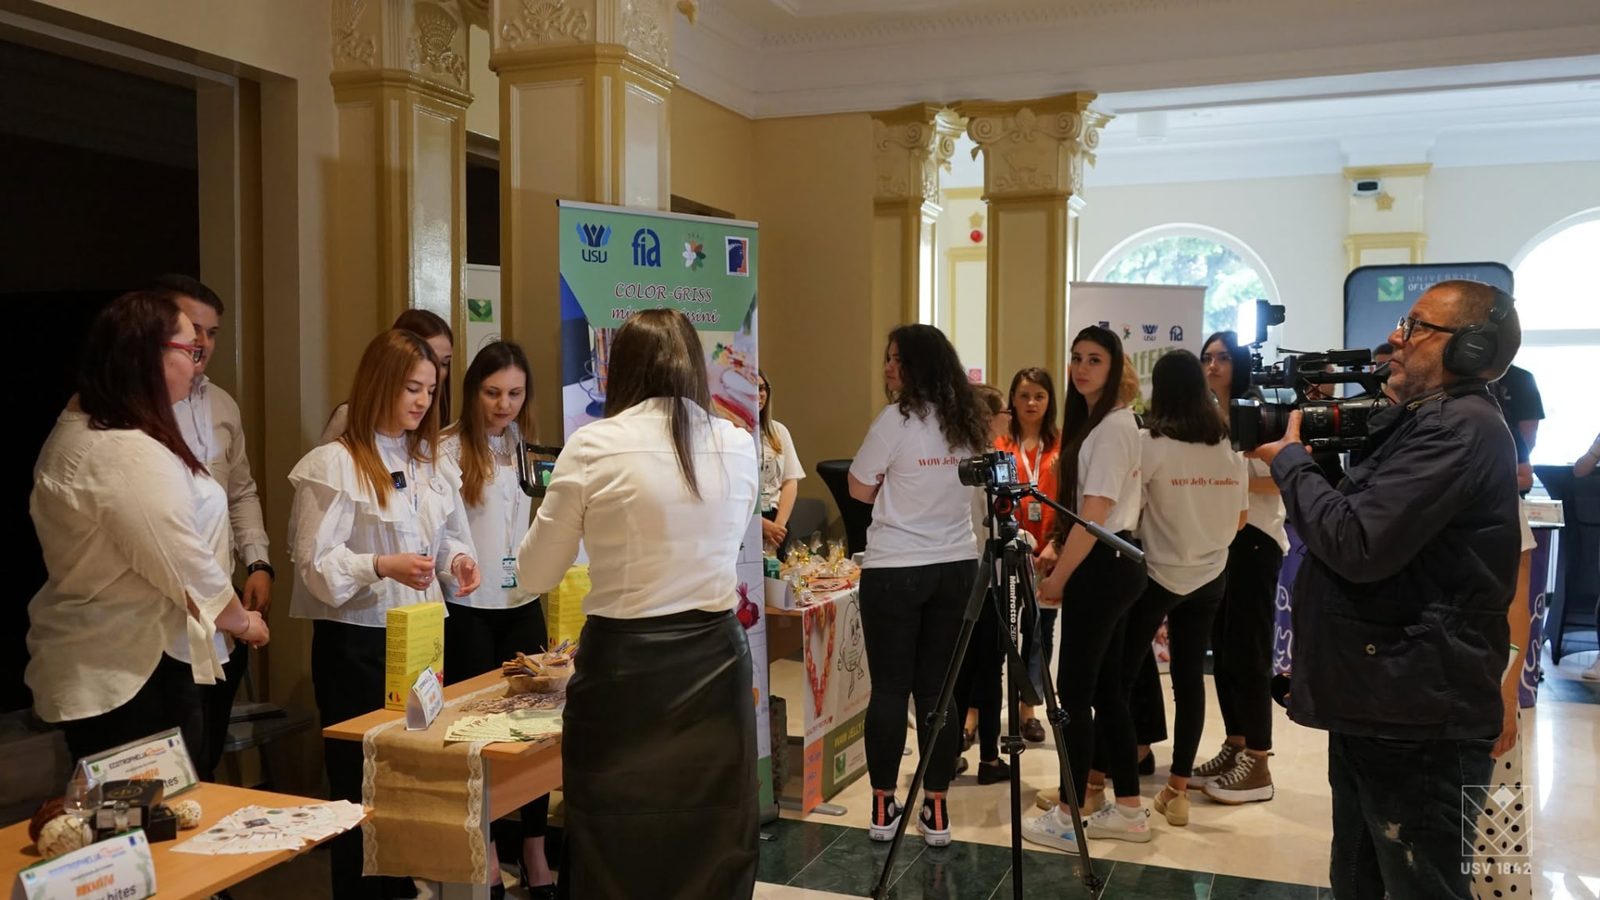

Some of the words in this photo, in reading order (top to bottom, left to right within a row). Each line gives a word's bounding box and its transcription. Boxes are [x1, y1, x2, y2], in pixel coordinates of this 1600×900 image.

[918, 458, 940, 466] WOW
[942, 456, 959, 466] Jelly
[1171, 478, 1189, 486] WOW
[1190, 477, 1207, 488] Jelly
[1209, 477, 1239, 486] Candies
[1009, 575, 1017, 624] Manfrotto
